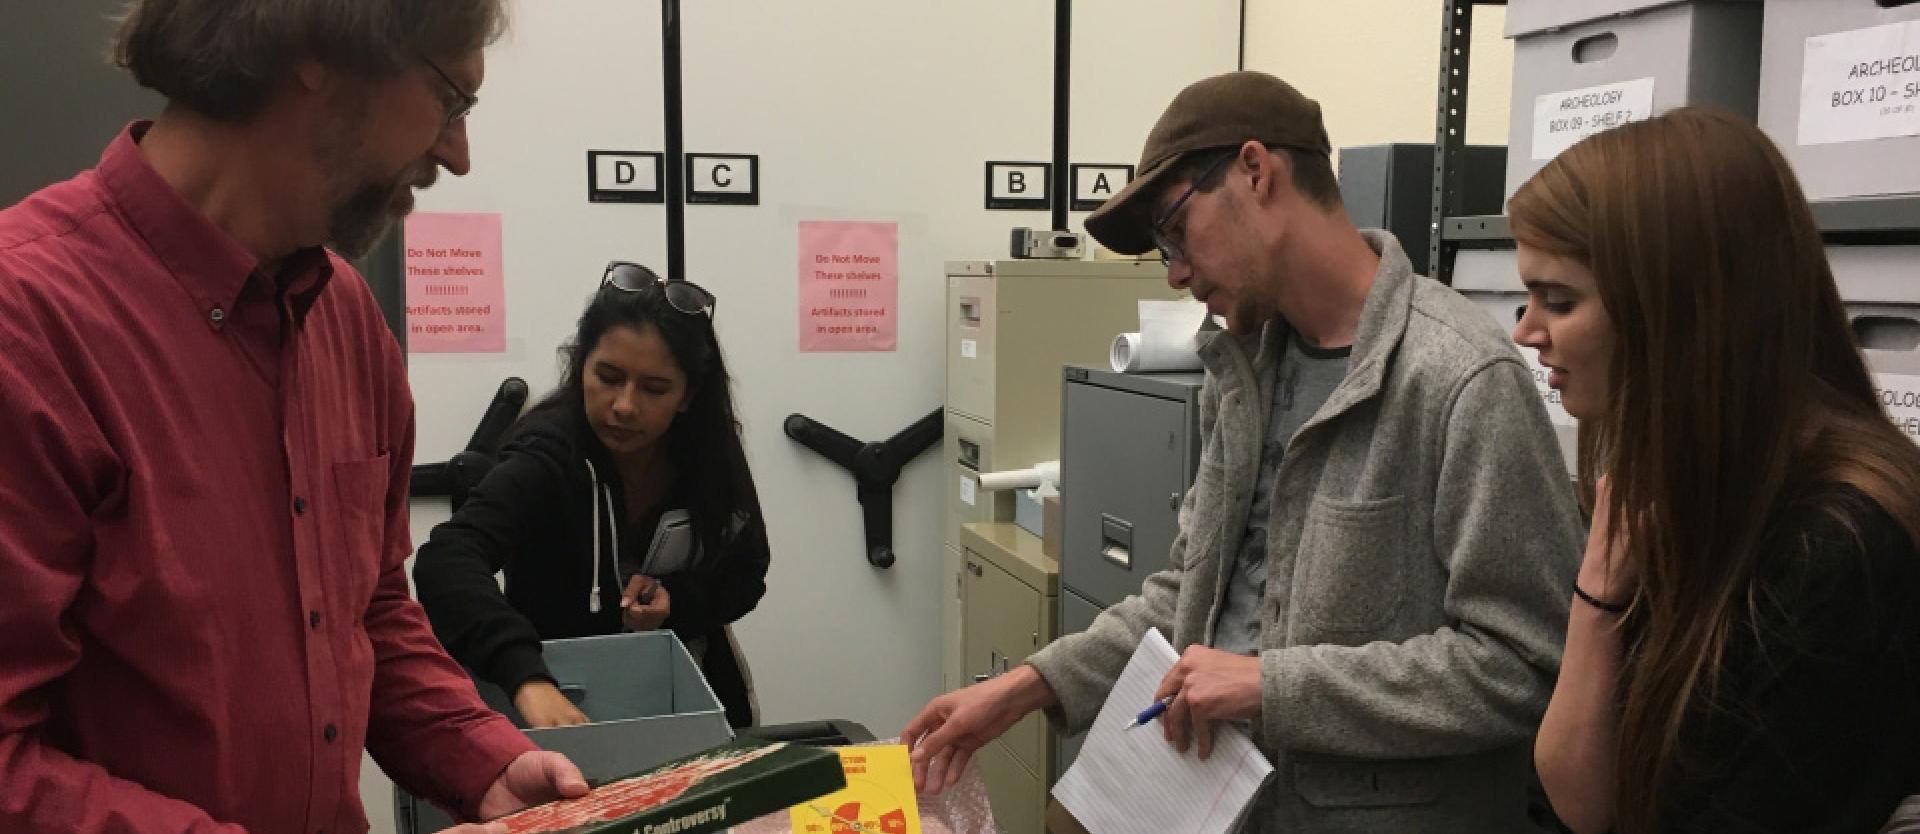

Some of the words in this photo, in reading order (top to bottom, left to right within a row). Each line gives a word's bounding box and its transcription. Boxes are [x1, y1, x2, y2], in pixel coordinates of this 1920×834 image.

[1560, 90, 1623, 111] ARCHEOLOGY
[1832, 89, 1864, 107] BOX
[1869, 85, 1886, 102] 10
[1550, 119, 1568, 133] BOX
[1592, 111, 1622, 127] SHELF
[616, 161, 636, 184] D
[711, 163, 732, 187] C
[1008, 171, 1026, 193] B
[1092, 172, 1111, 193] A
[407, 248, 423, 258] Do
[426, 248, 447, 258] Not
[449, 248, 482, 258] Move
[815, 254, 830, 263] Do
[832, 254, 850, 263] Not
[853, 254, 880, 263] Move
[408, 266, 440, 275] These
[443, 266, 484, 275] shelves
[815, 270, 844, 279] These
[846, 271, 880, 280] shelves
[405, 304, 453, 315] Artifacts
[455, 304, 491, 315] stored
[811, 307, 852, 317] Artifacts
[854, 307, 885, 317] stored
[411, 323, 423, 333] in
[425, 323, 455, 335] open
[456, 324, 485, 333] area.
[816, 325, 826, 333] in
[828, 325, 853, 335] open
